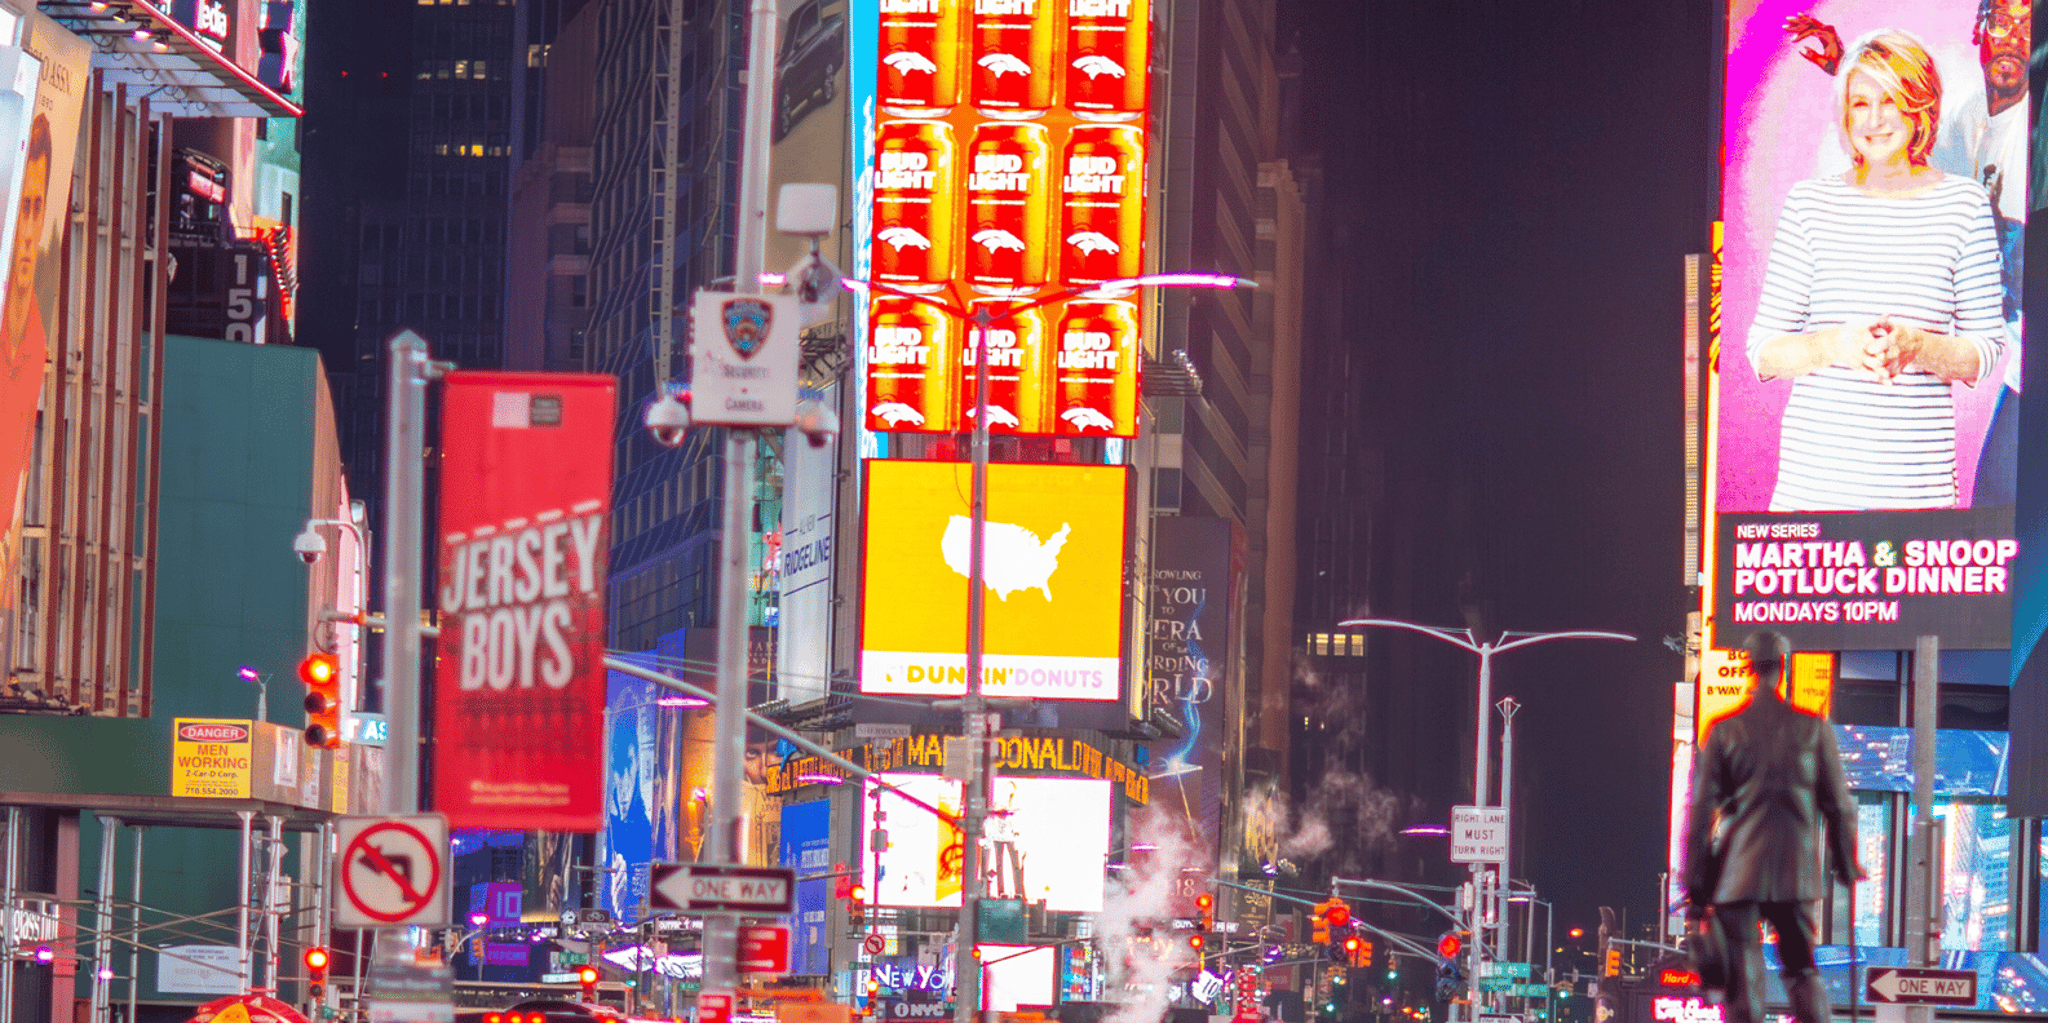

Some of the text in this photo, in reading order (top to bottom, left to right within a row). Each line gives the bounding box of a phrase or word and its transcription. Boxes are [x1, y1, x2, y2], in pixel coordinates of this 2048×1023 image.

[880, 152, 928, 171] BUD
[975, 154, 1022, 173] BUD
[1069, 157, 1117, 175] BUD
[874, 171, 937, 189] LIGHT
[969, 173, 1031, 191] LIGHT
[1063, 175, 1126, 193] LIGHT
[874, 327, 922, 346] BUD
[1063, 332, 1111, 350] BUD
[868, 346, 931, 364] LIGHT
[1057, 351, 1120, 369] LIGHT
[1736, 523, 1819, 539] NEW SERIES
[783, 536, 831, 578] RIDGELINE
[1735, 539, 2018, 569] MARTHA & SNOOP
[441, 514, 602, 614] JERSEY
[1734, 566, 2007, 595] POTLUCK DINNER
[1162, 587, 1207, 604] YOU
[1161, 606, 1175, 615] TO
[1734, 600, 1899, 623] MONDAYS 10PM
[1154, 619, 1203, 641] ERA
[461, 601, 573, 691] BOYS
[1162, 642, 1176, 651] OF
[906, 665, 1103, 689] DUNIN' DONUTS
[1707, 686, 1742, 695] B'WAY
[187, 727, 239, 739] DANGER
[857, 725, 909, 736] SHERWOOD
[198, 744, 229, 756] MEN
[178, 756, 248, 770] WORKING
[1455, 814, 1505, 823] RIGHT LANE
[1465, 829, 1495, 840] MUST
[1454, 845, 1505, 855] TURN RIGHT
[692, 879, 780, 900] ONE WAY
[876, 963, 944, 989] NEW YO
[1663, 973, 1690, 983] Hard
[1898, 978, 1967, 995] ONE WAY
[910, 1003, 945, 1016] NYC
